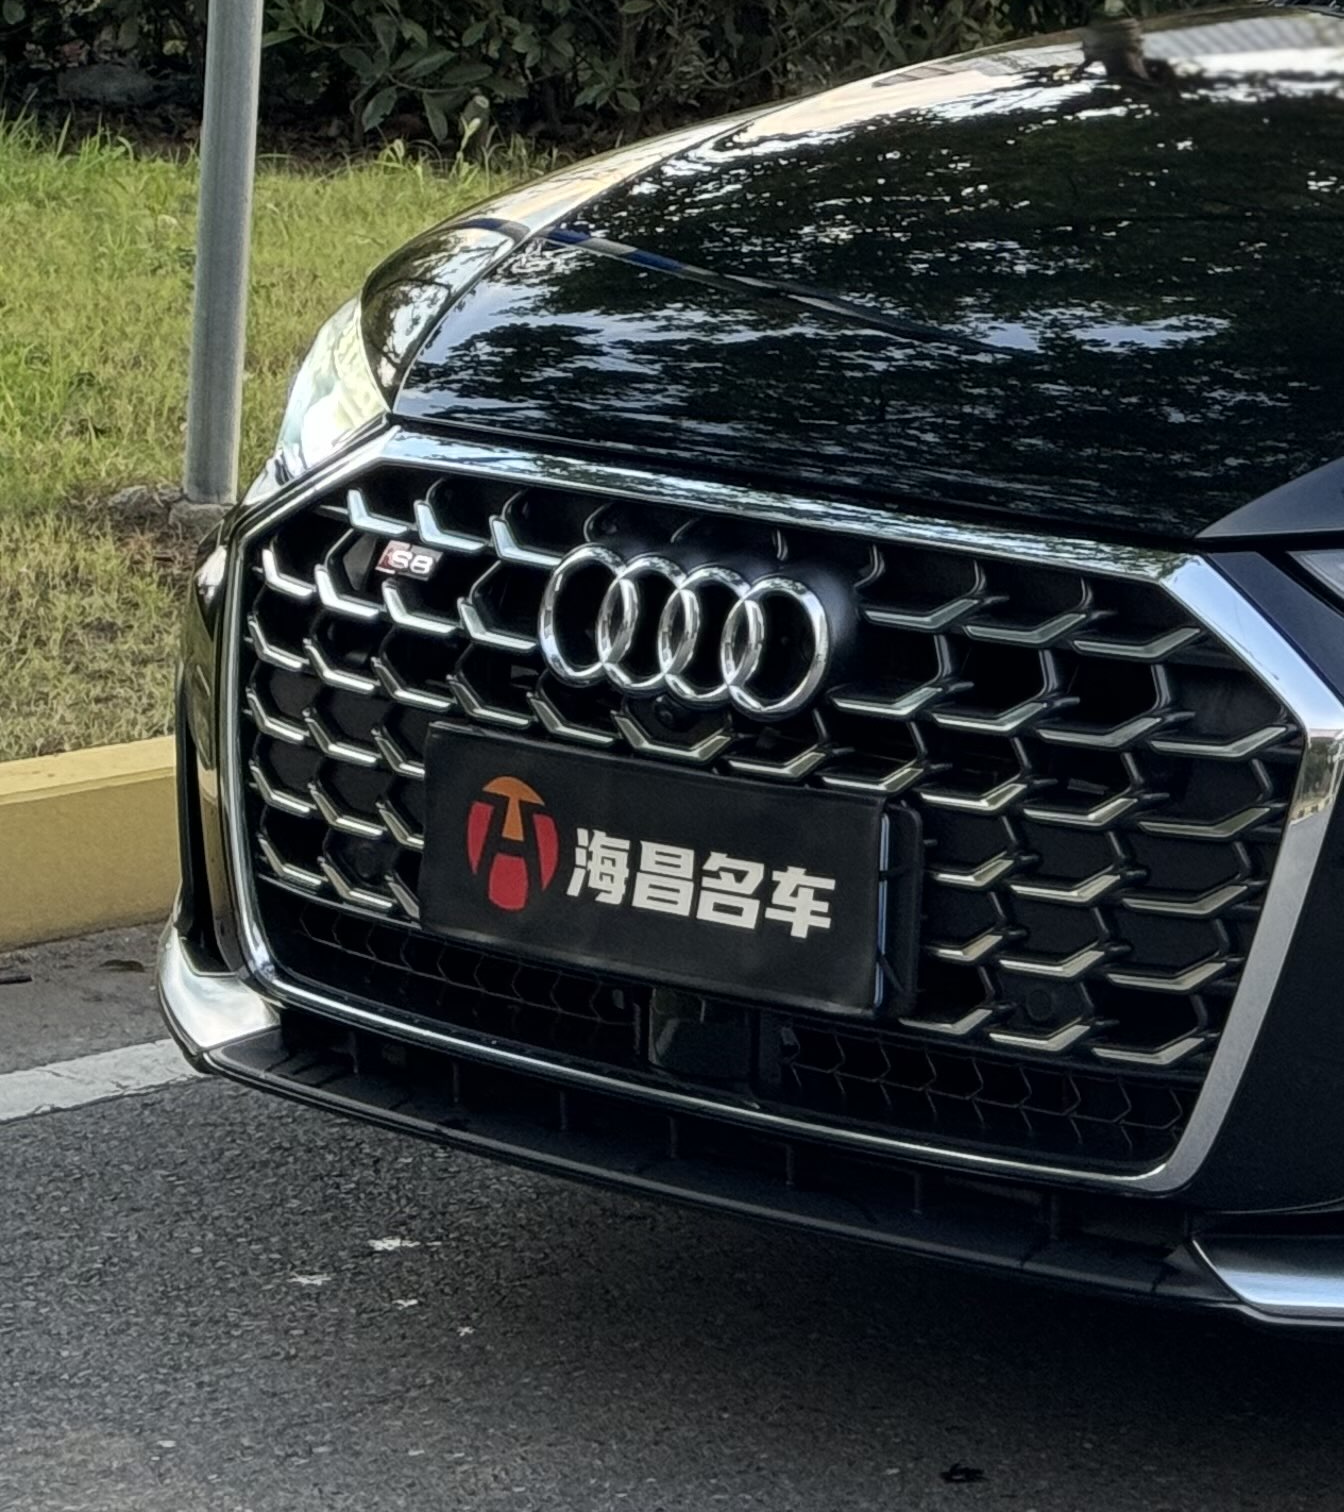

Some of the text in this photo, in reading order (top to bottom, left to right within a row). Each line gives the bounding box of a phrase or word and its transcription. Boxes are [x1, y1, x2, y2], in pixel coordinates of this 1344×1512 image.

[387, 549, 435, 575] S8
[566, 827, 837, 939] 海昌名车
